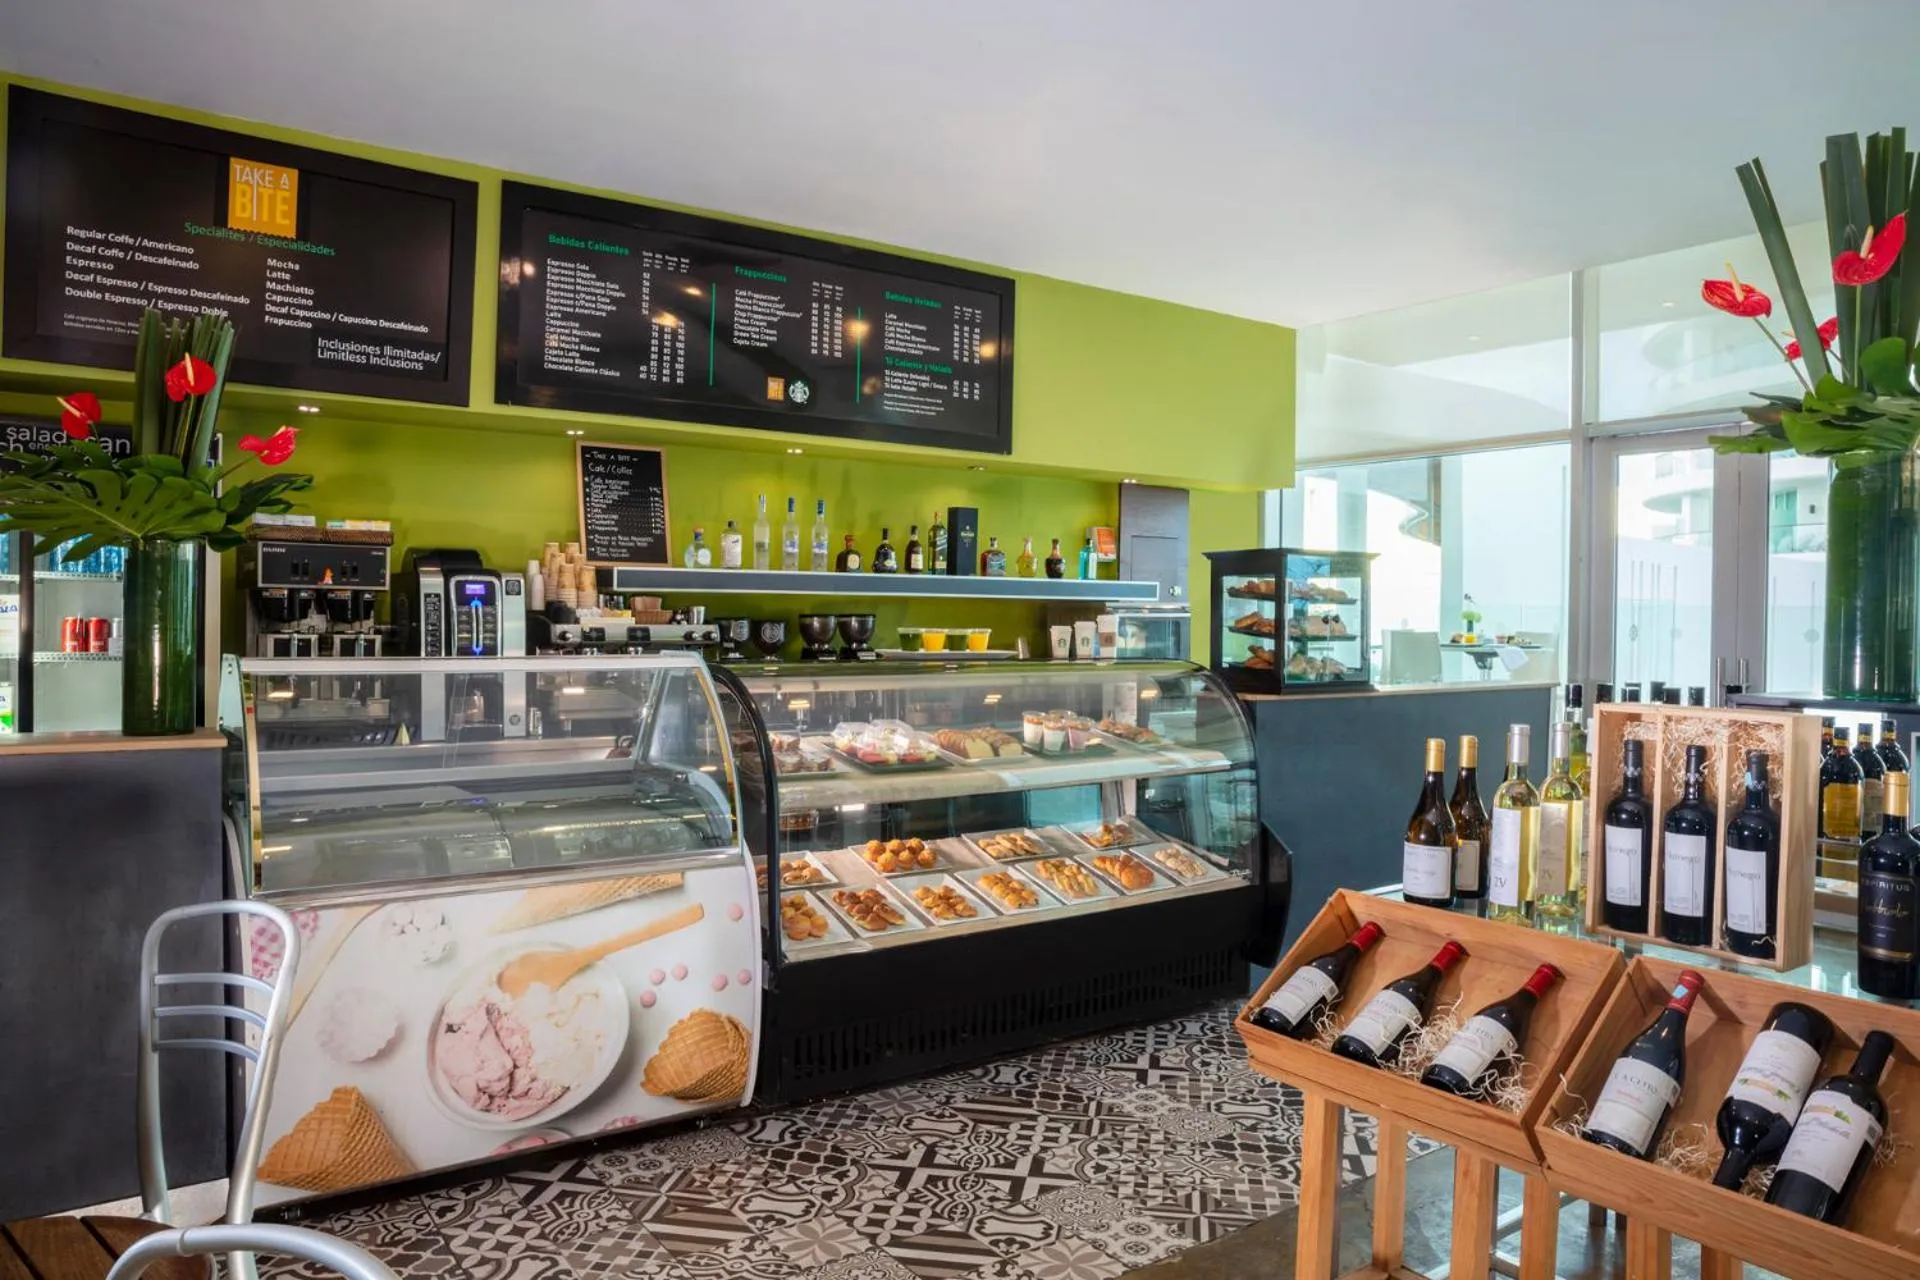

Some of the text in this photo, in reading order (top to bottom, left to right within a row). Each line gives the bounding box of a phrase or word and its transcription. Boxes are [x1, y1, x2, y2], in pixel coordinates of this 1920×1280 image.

[234, 164, 289, 189] TAKE A
[235, 182, 290, 225] BITE
[66, 226, 106, 240] Regular
[108, 232, 134, 245] Coffe
[258, 235, 336, 256] Especialidades
[66, 242, 96, 254] Decaf
[98, 246, 124, 259] Coffe
[134, 252, 200, 270] Descafeinado
[66, 256, 114, 270] Espresso
[266, 258, 300, 270] Mocha
[266, 270, 292, 280] Latte
[65, 270, 94, 283] Decaf
[96, 274, 139, 290] Espresso
[148, 282, 188, 296] Espresso
[190, 289, 250, 304] Descafeinado
[266, 281, 314, 296] Machiatto
[65, 287, 102, 300] Double
[104, 292, 148, 306] Espresso
[158, 300, 199, 314] Espresso
[201, 306, 228, 317] Doble
[265, 292, 313, 306] Capuccino
[264, 315, 312, 329] Frapuccino
[265, 304, 289, 314] Decaf
[290, 308, 332, 320] Capuccino
[338, 314, 378, 326] Capuccino
[379, 319, 429, 334] Descafeinado
[318, 338, 380, 356] Inclusiones
[318, 348, 424, 370] Limitless Inclusions
[6, 426, 67, 444] salad
